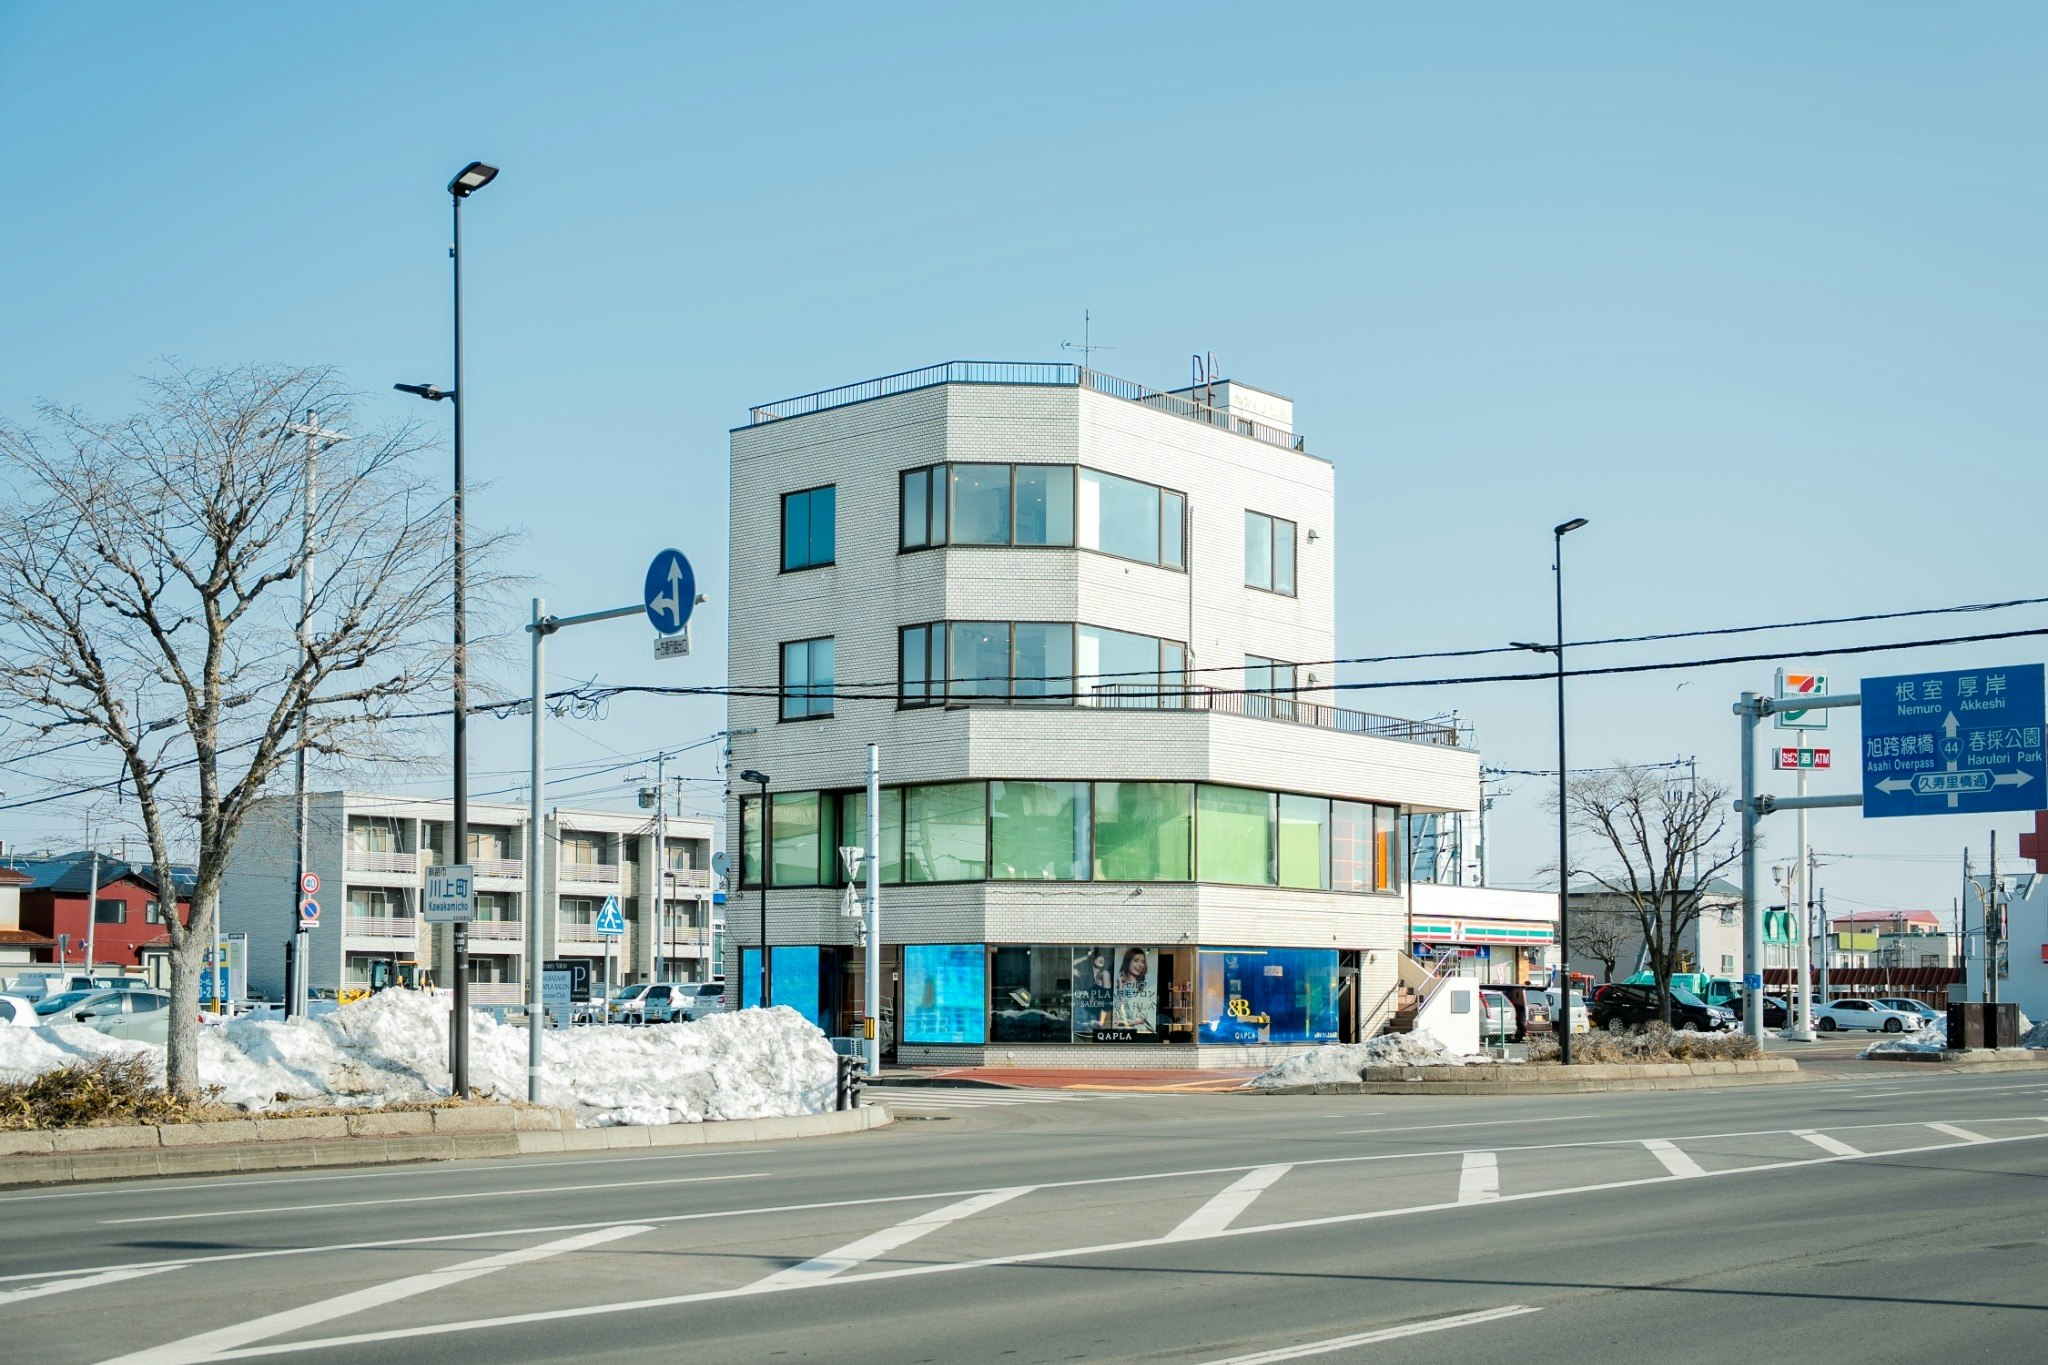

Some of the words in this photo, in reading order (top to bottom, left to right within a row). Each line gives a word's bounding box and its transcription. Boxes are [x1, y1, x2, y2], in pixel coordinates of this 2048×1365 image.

[1896, 680, 1943, 702] 根室
[1957, 674, 2007, 698] 厚岸
[1897, 704, 1942, 716] Nemuro
[1960, 697, 2006, 711] Akkeshi
[1867, 733, 1934, 758] 旭跨線橋
[1969, 727, 2040, 751] 春採公園
[1944, 741, 1959, 754] 44
[1800, 752, 1811, 764] 酒
[1815, 753, 1830, 764] ATM
[1967, 752, 2011, 766] Harutori
[2017, 751, 2043, 763] Park
[1867, 760, 1892, 772] Asahi
[1894, 759, 1935, 771] Overpass
[306, 878, 316, 888] 40
[429, 879, 469, 898] 川上町
[428, 901, 469, 911] Kawakamicho
[1074, 990, 1111, 999] QAPLA
[1080, 1000, 1105, 1008] SALON
[1227, 999, 1251, 1018] &B
[1097, 1032, 1132, 1041] QAPLA
[1235, 1032, 1256, 1040] QAPLA
